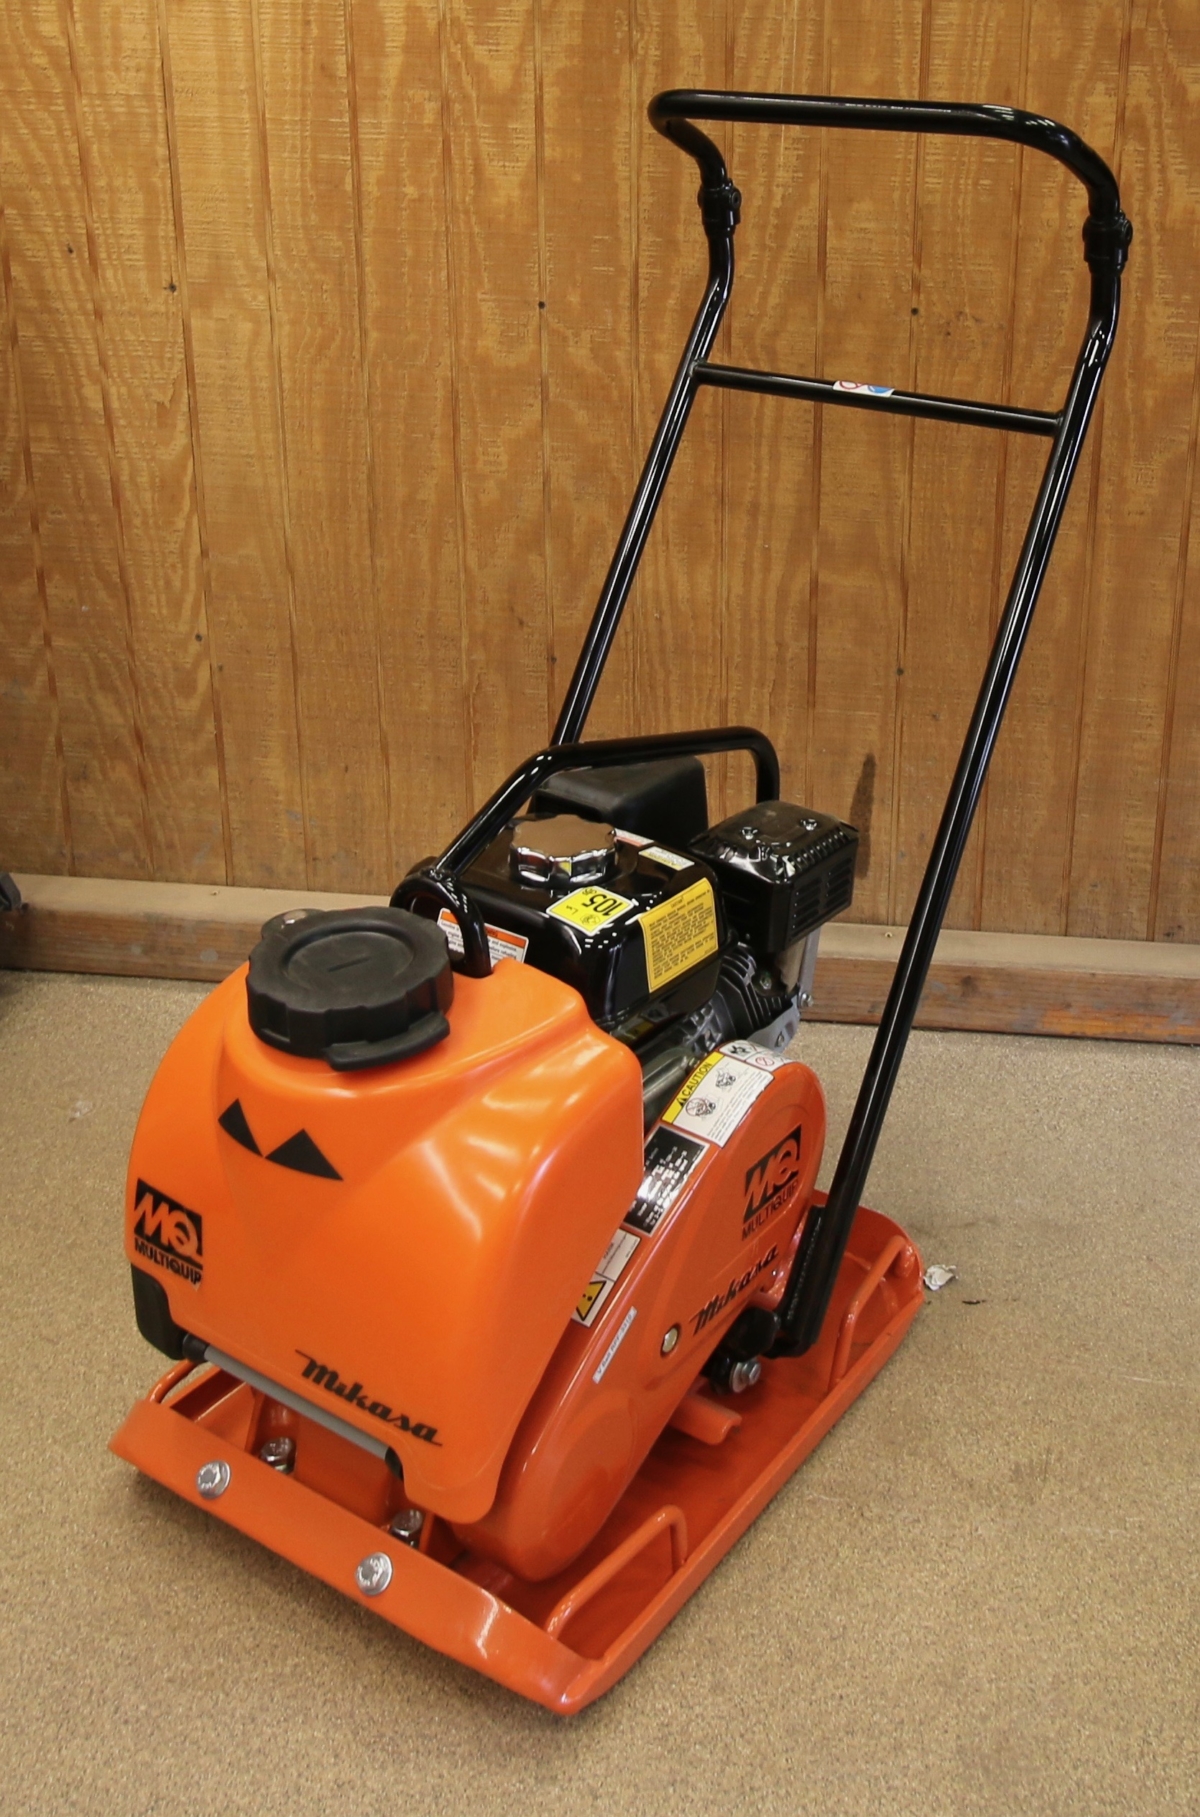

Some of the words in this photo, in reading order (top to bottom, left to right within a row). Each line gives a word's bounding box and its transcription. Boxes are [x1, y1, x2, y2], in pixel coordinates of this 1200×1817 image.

[581, 893, 623, 916] 105
[681, 1061, 713, 1097] CAUTION
[134, 1181, 203, 1262] MQ
[741, 1178, 800, 1241] MULTIQUIP
[134, 1236, 203, 1286] MULTIQUIP
[689, 1245, 779, 1336] Mikasa
[295, 1349, 443, 1447] Mikasa
